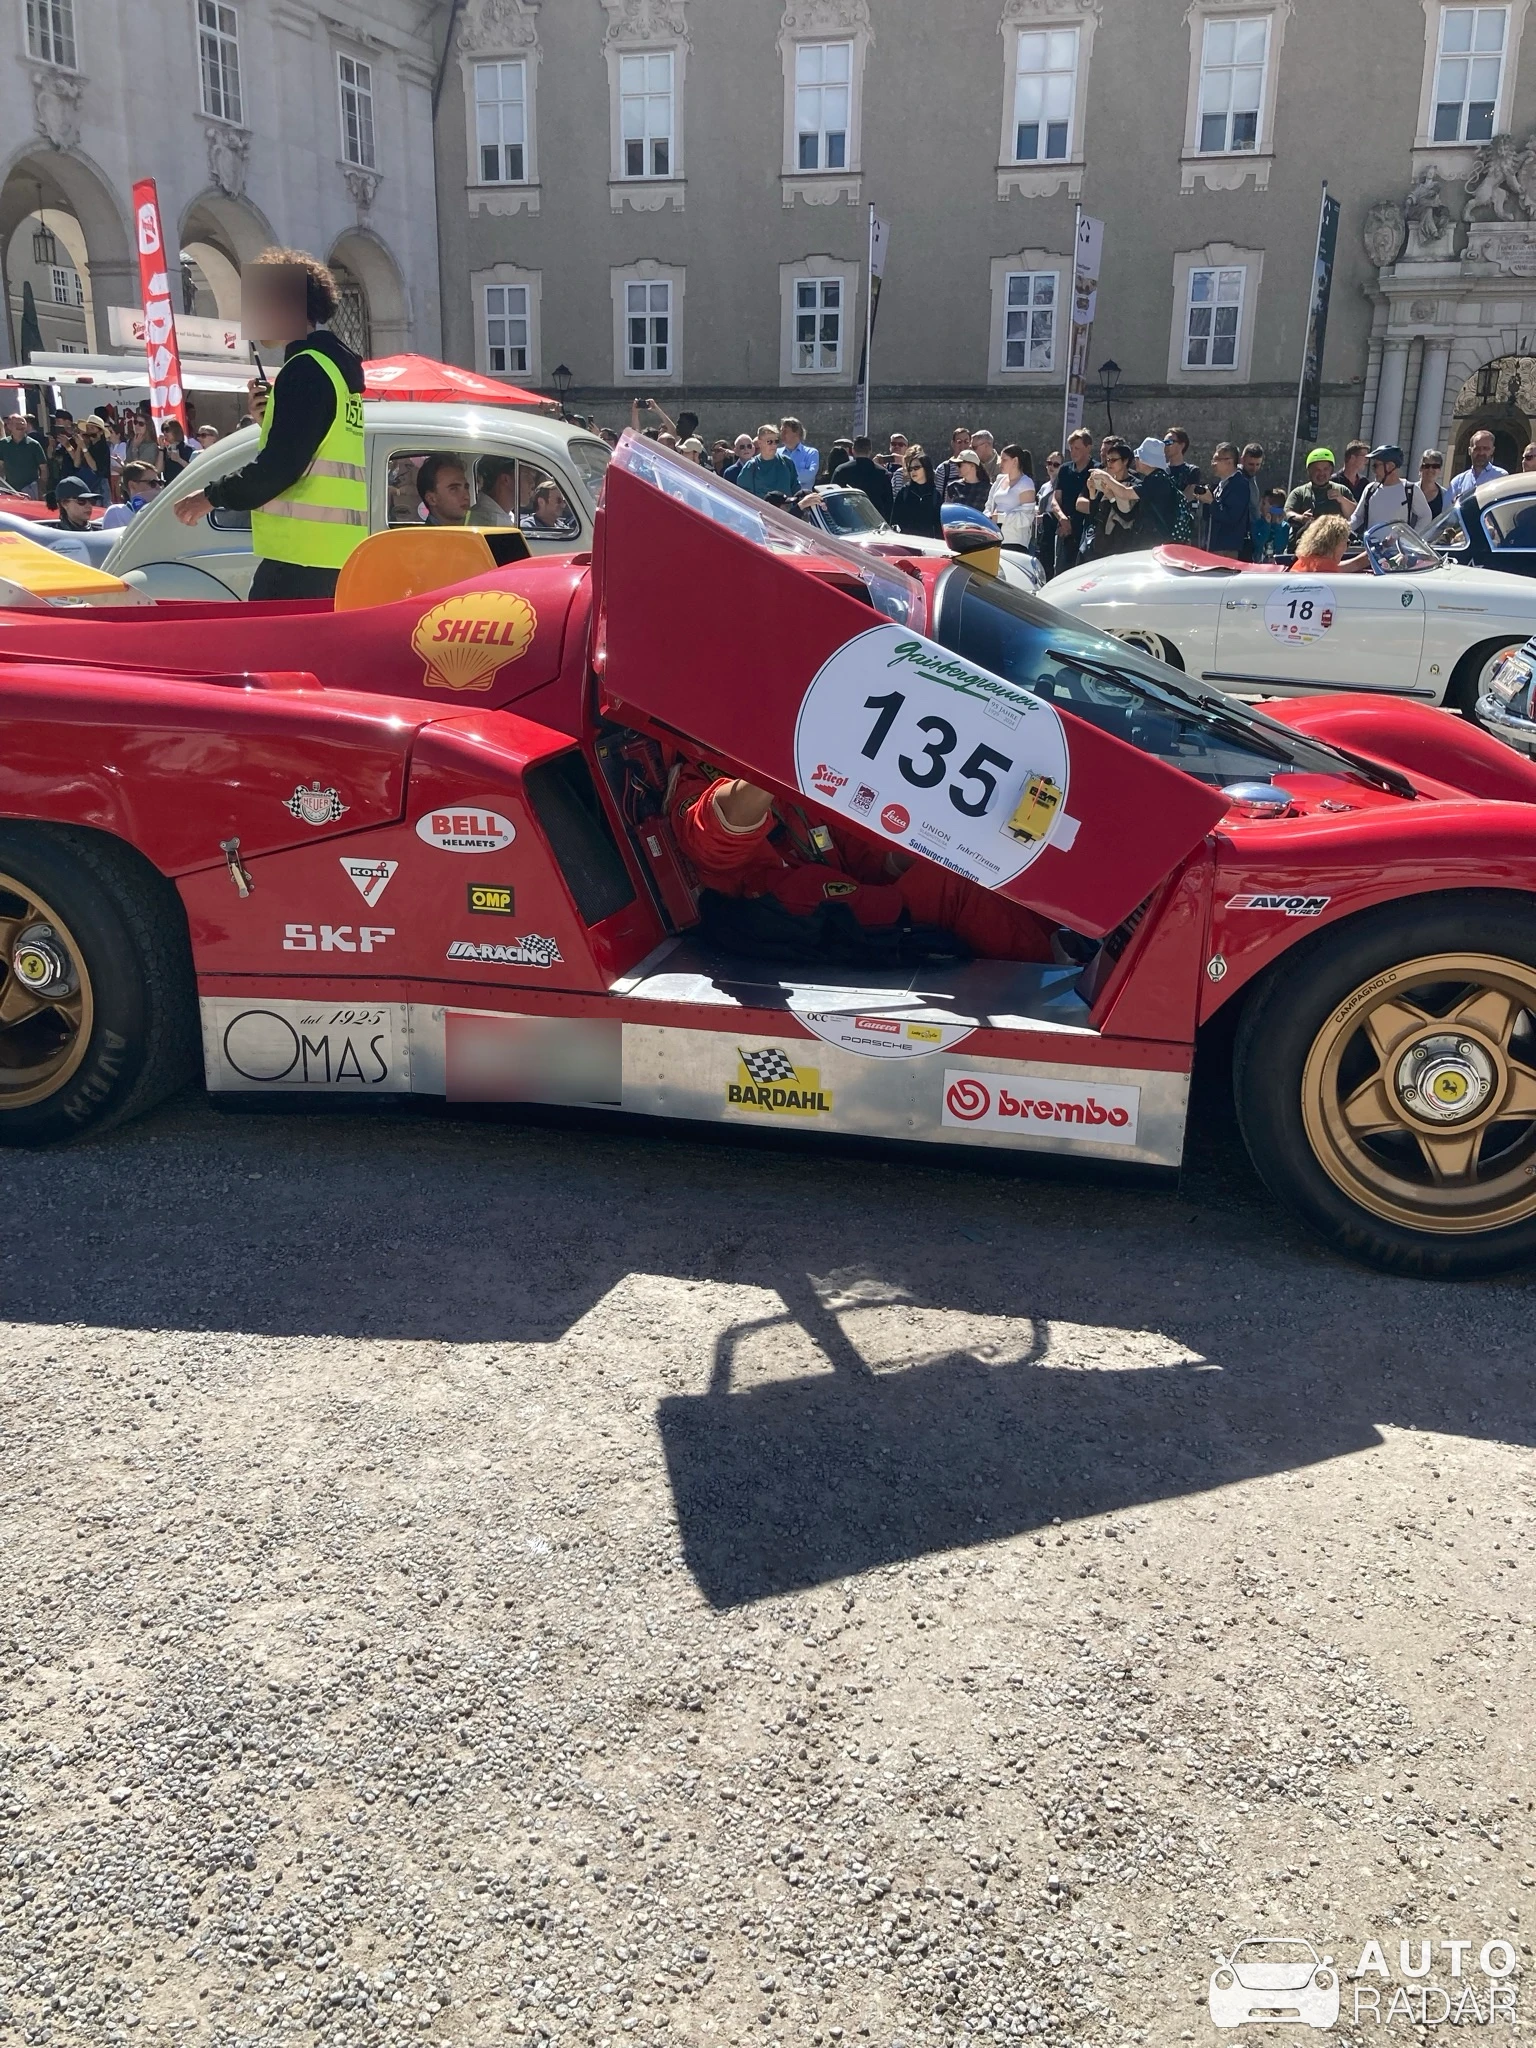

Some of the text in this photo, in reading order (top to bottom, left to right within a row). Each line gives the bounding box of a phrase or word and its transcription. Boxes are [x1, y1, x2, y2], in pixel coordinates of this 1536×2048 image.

[1287, 599, 1314, 620] 18
[432, 619, 515, 646] SHELL
[999, 704, 1018, 721] JAHRE
[860, 690, 1014, 818] 135
[811, 763, 849, 787] Stiegl
[304, 797, 329, 810] HEUER
[853, 798, 870, 810] EXPO
[432, 815, 503, 837] BELL
[882, 810, 907, 828] Leica
[922, 821, 951, 841] UNION
[442, 838, 496, 848] HELMETS
[908, 838, 944, 864] Salzburger
[957, 843, 1001, 872] fahr(T)raum
[352, 868, 388, 877] KONI
[472, 891, 511, 908] OMP
[1250, 896, 1329, 909] AVON
[283, 924, 396, 953] SKF
[1335, 973, 1397, 1023] CAMPAGNOLO
[300, 1010, 386, 1026] dal 1925
[807, 1012, 829, 1023] OCC
[223, 1010, 388, 1083] OMAS
[841, 1035, 913, 1051] PORSCHE
[728, 1084, 830, 1111] BARDAHL
[998, 1089, 1129, 1128] brembo
